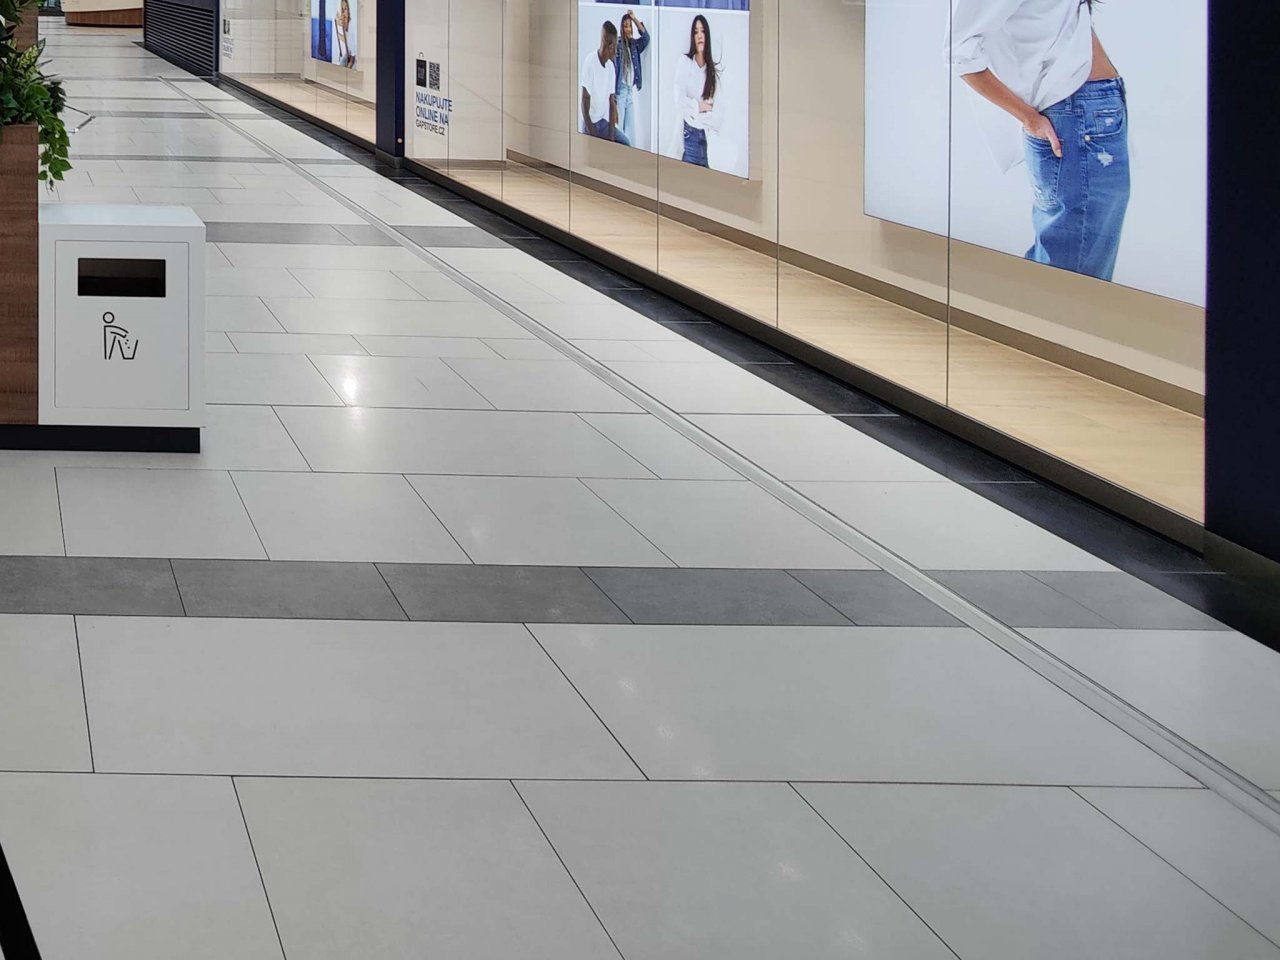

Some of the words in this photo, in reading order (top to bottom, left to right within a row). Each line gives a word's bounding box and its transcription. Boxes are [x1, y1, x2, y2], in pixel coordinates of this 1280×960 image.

[416, 91, 452, 112] NAKUPUJTE
[416, 106, 438, 123] ONLINE
[439, 112, 449, 126] NA
